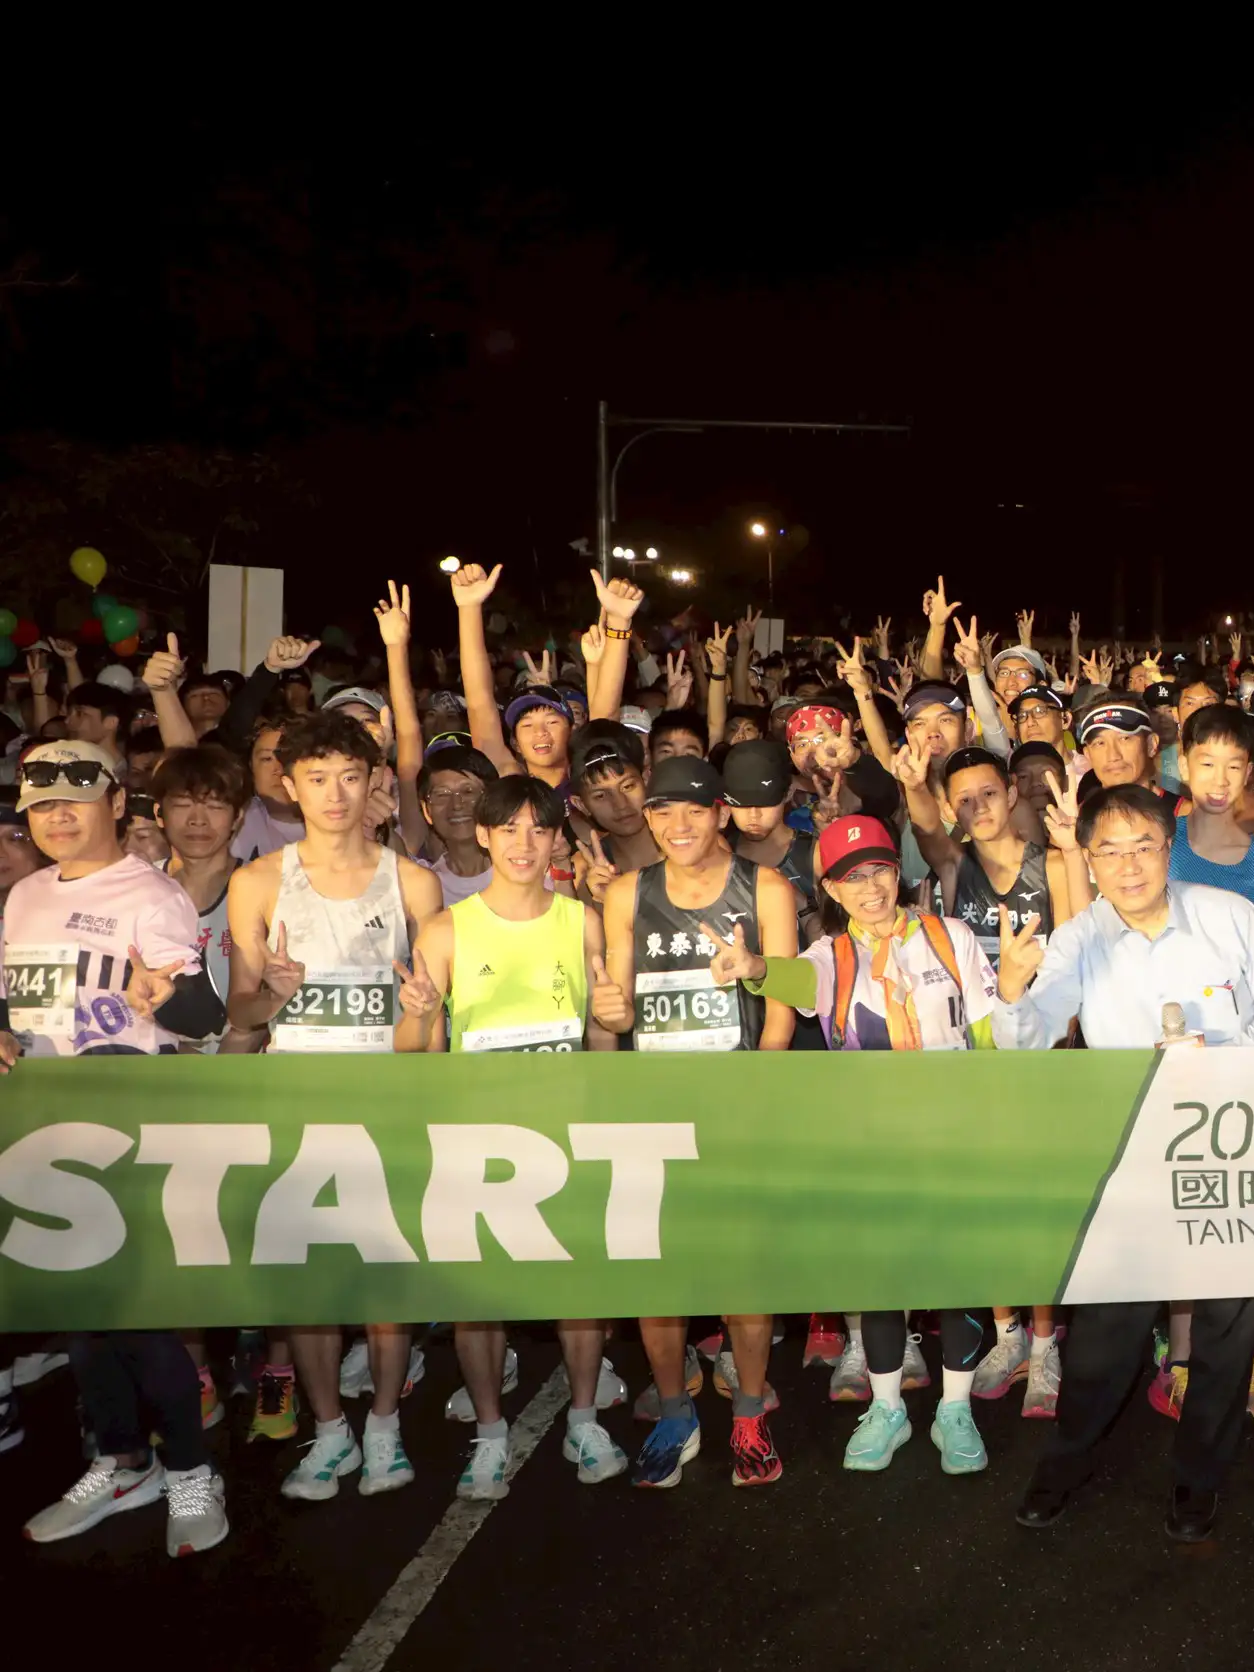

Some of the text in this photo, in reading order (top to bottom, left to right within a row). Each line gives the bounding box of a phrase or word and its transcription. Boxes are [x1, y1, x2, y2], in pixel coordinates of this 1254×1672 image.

[285, 987, 385, 1016] 32198
[642, 990, 730, 1023] 50163
[0, 1121, 699, 1271] START
